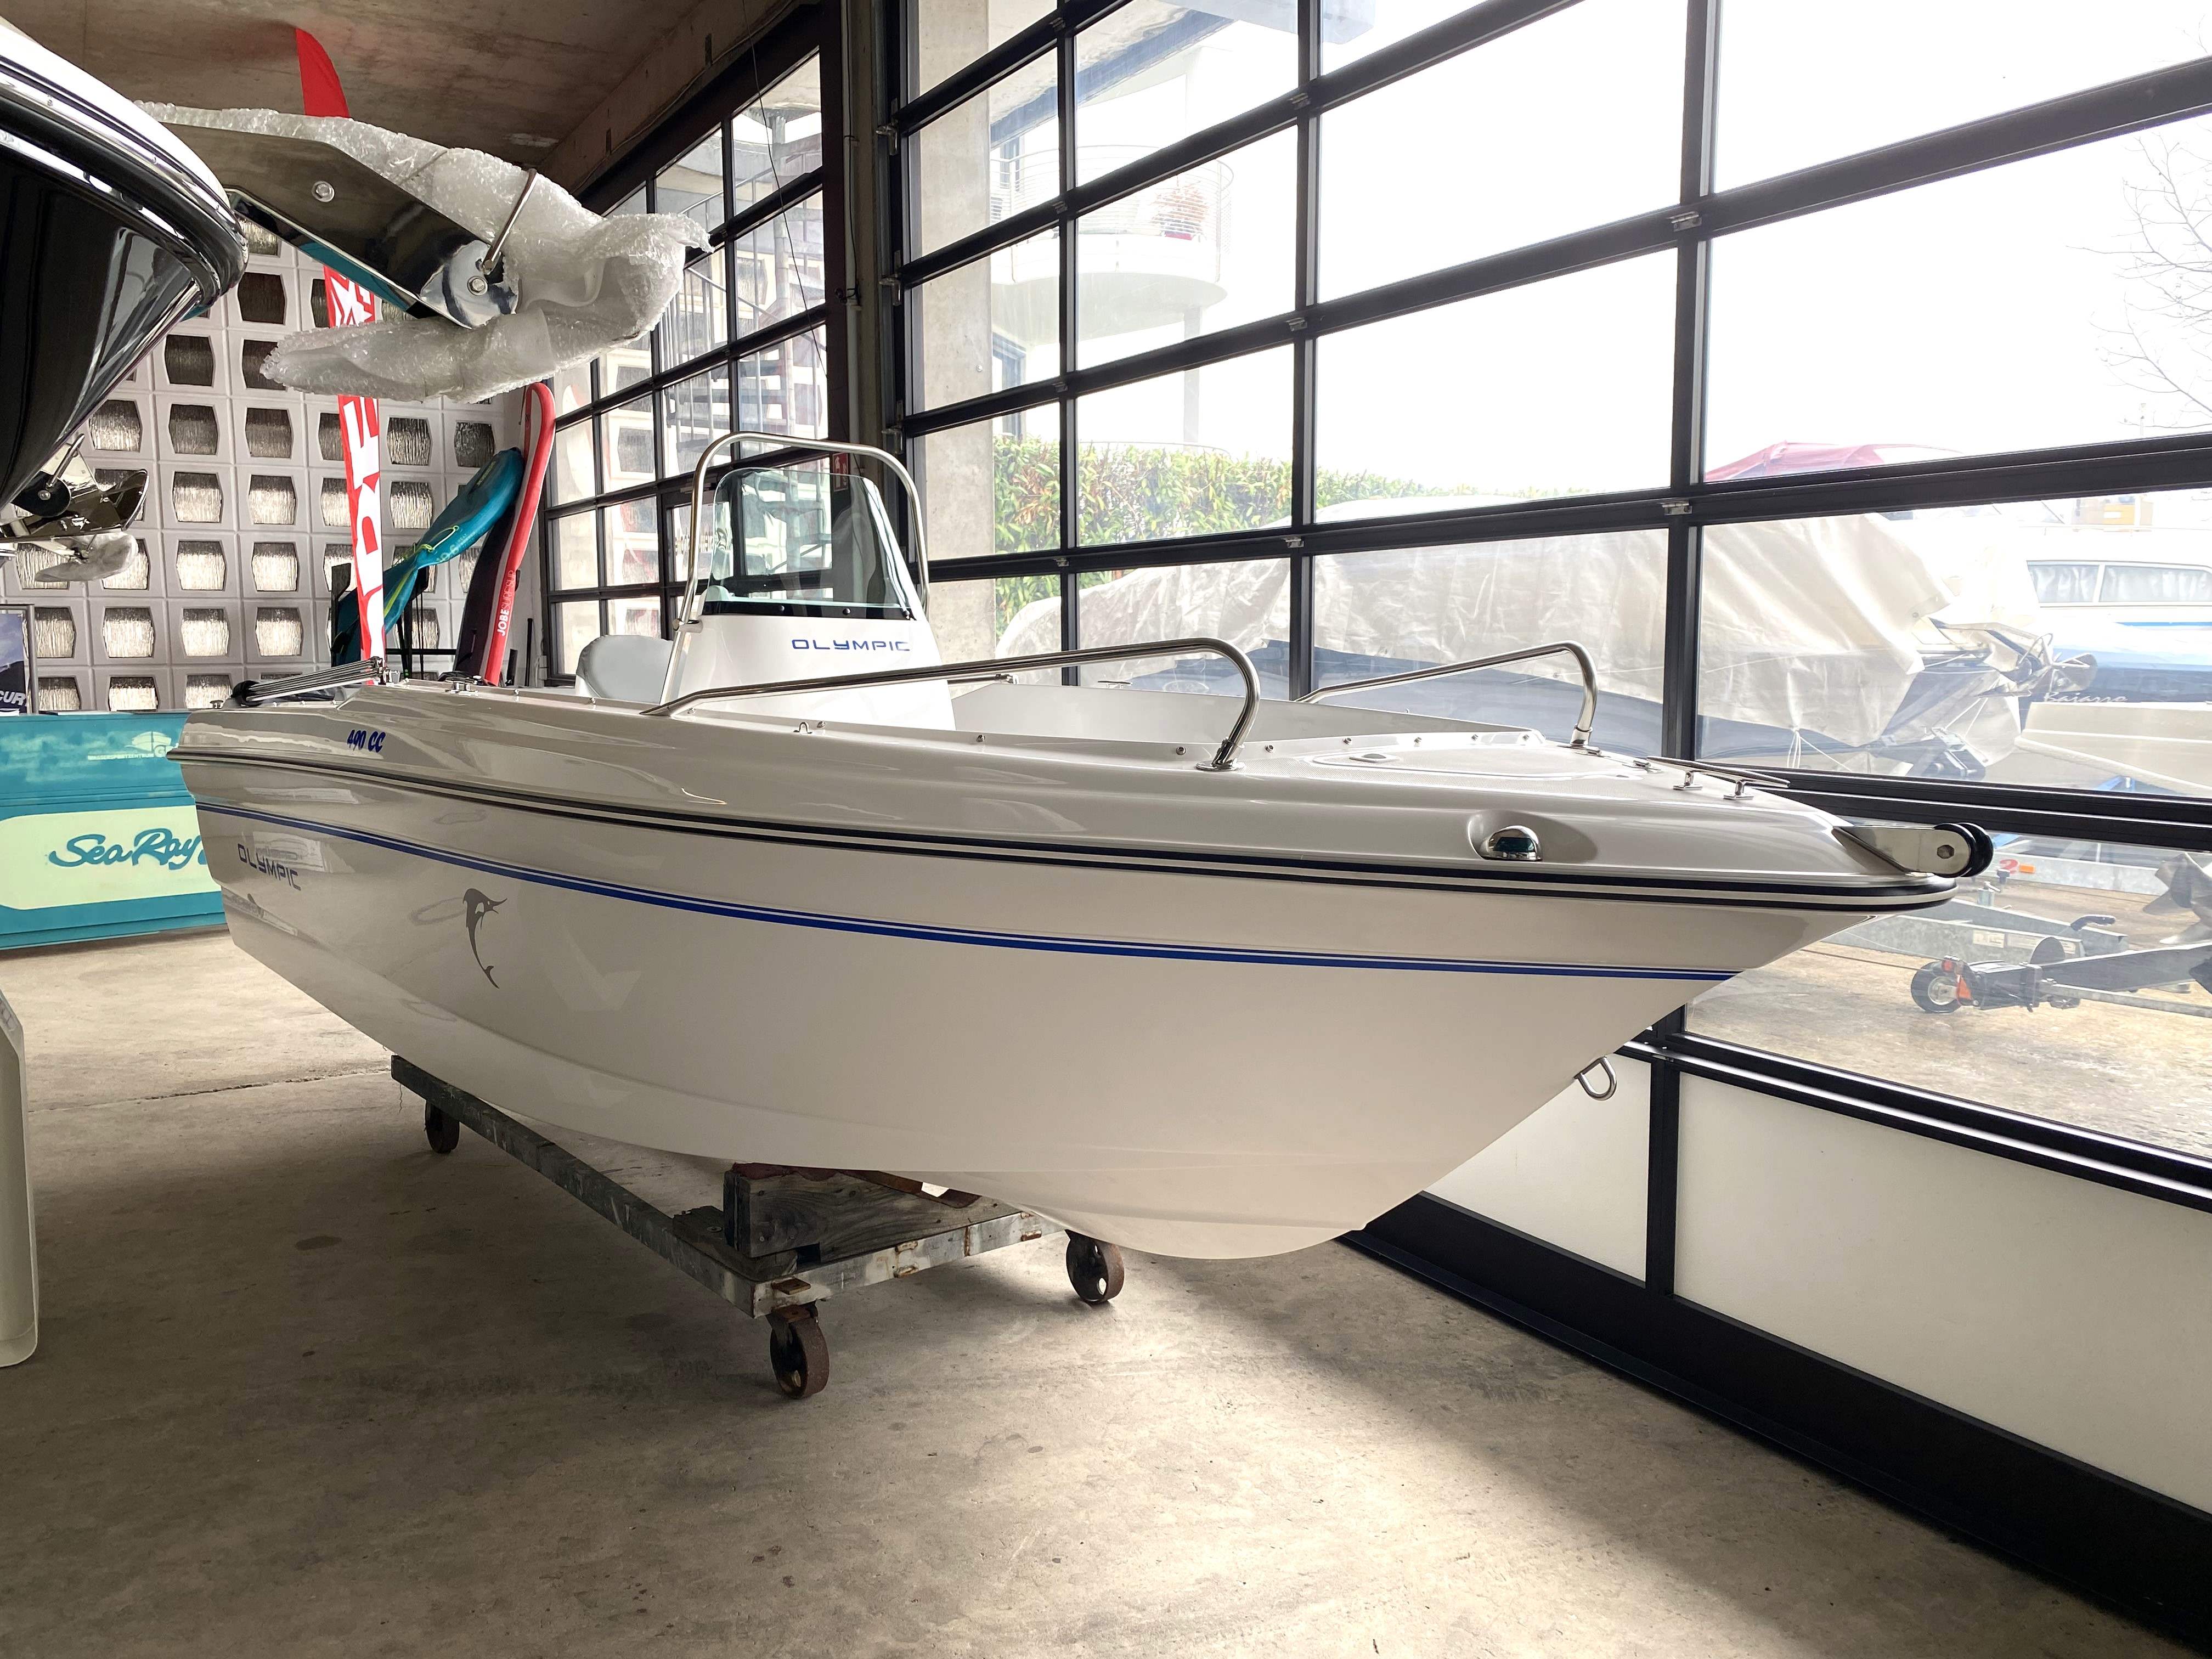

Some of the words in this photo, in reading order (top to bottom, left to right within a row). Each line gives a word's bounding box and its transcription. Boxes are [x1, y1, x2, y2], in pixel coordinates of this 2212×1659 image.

[497, 609, 510, 636] JOBE
[792, 640, 910, 651] OLYMPIC
[347, 729, 366, 751] 490
[368, 731, 386, 753] CC
[238, 843, 301, 891] OLYMPIC
